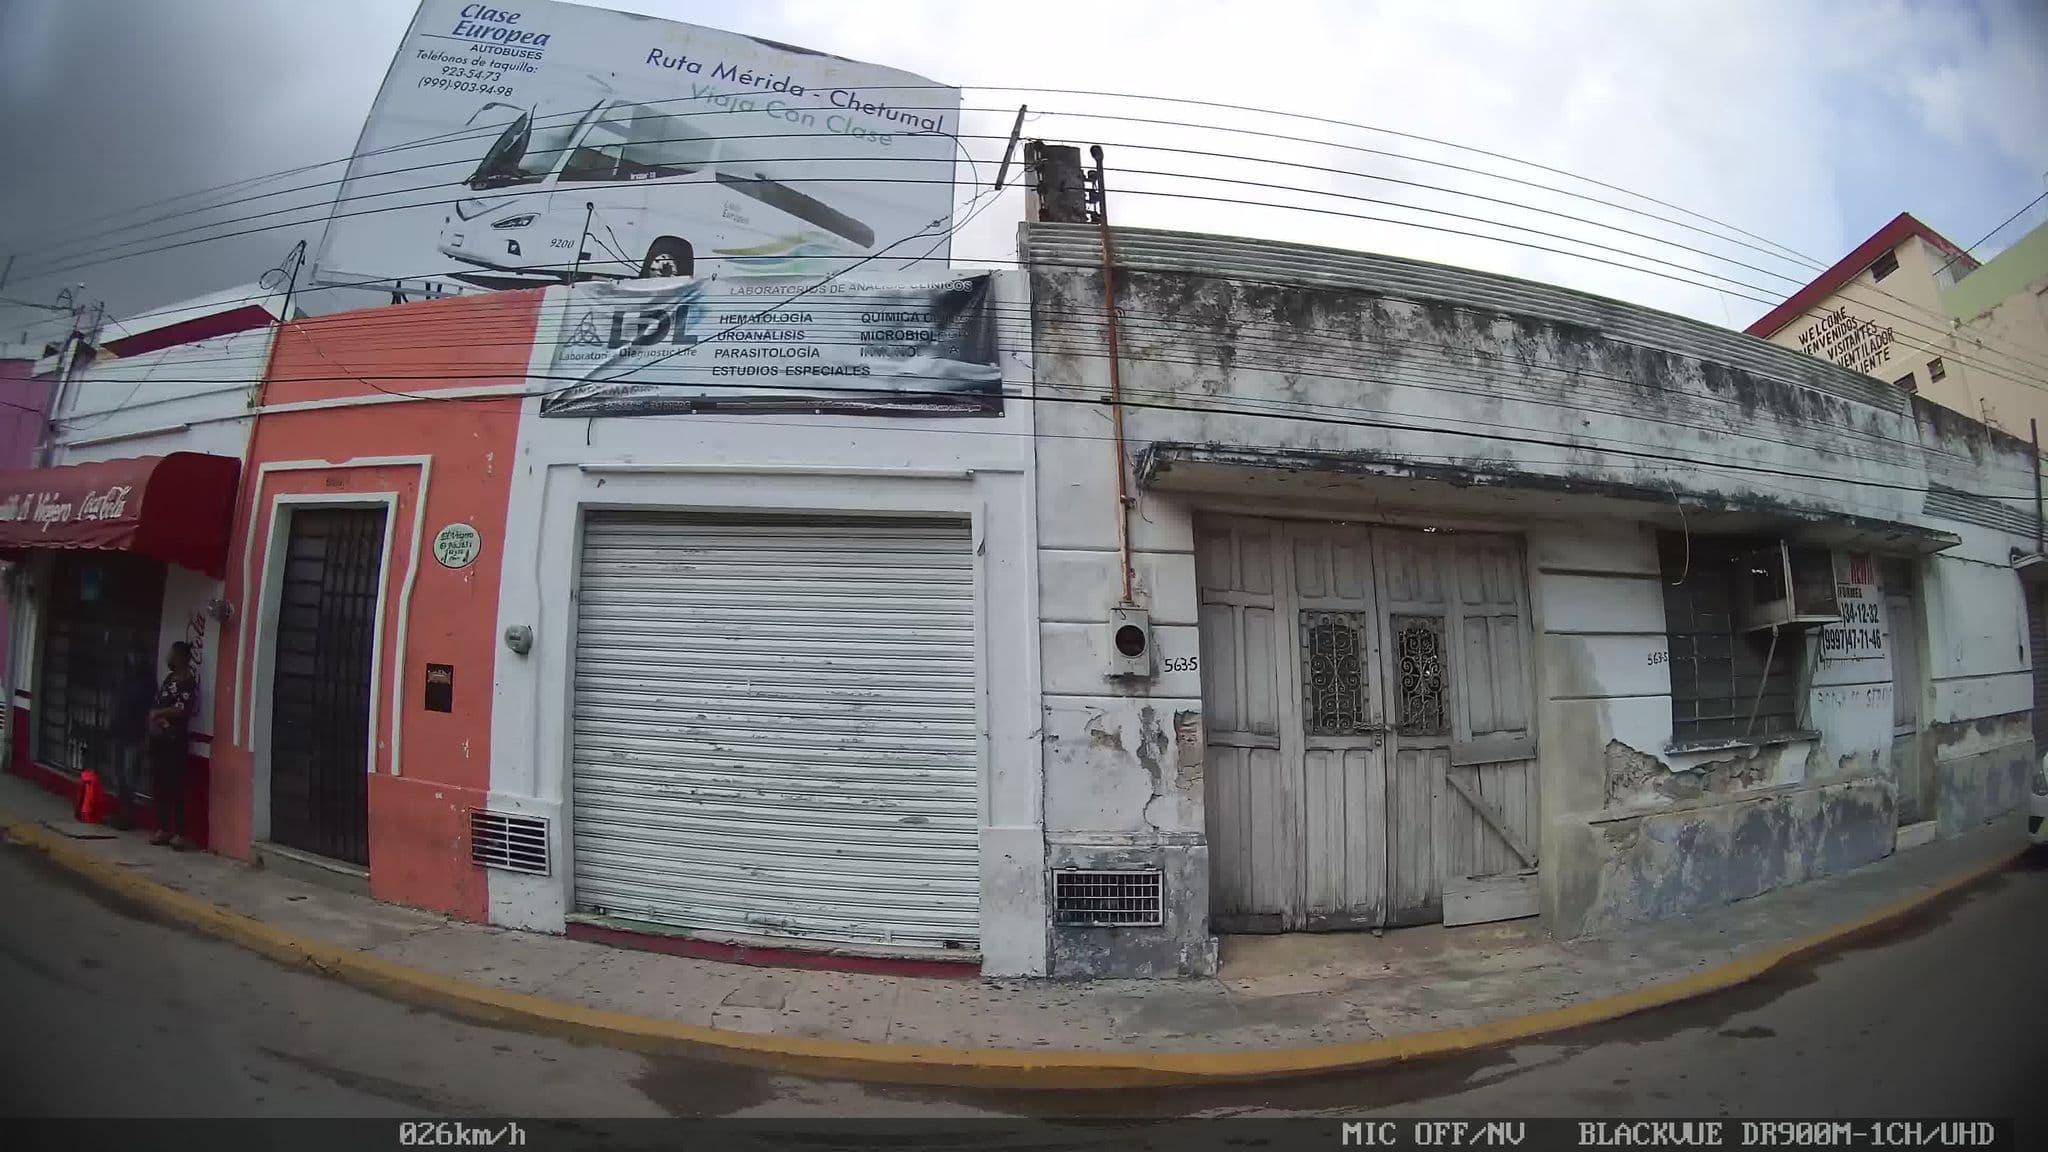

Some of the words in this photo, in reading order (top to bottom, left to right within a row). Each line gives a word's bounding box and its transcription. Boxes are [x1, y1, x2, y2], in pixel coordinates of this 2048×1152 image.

[461, 3, 521, 24] Clase
[452, 20, 551, 46] Europea
[470, 44, 543, 60] AUTOBUSES
[442, 66, 501, 82] 923-54-73
[471, 56, 486, 67] de
[490, 60, 538, 74] taquilla:
[646, 48, 703, 74] Ruta
[711, 62, 806, 97] Mérida
[830, 89, 944, 132] Chetumal
[691, 83, 755, 113] Viaja
[766, 100, 815, 128] Con
[826, 114, 893, 146] Clase
[550, 238, 575, 249] 9200
[730, 284, 827, 296] LABORATORIOS
[829, 284, 846, 293] DE
[608, 304, 699, 350] LDL
[1798, 306, 1847, 345] WELCOME
[1800, 316, 1858, 356] IENVENIDOS
[1827, 319, 1878, 360] VISITANTES
[712, 366, 779, 376] ESTUDIOS
[785, 366, 871, 377] ESPECIALES
